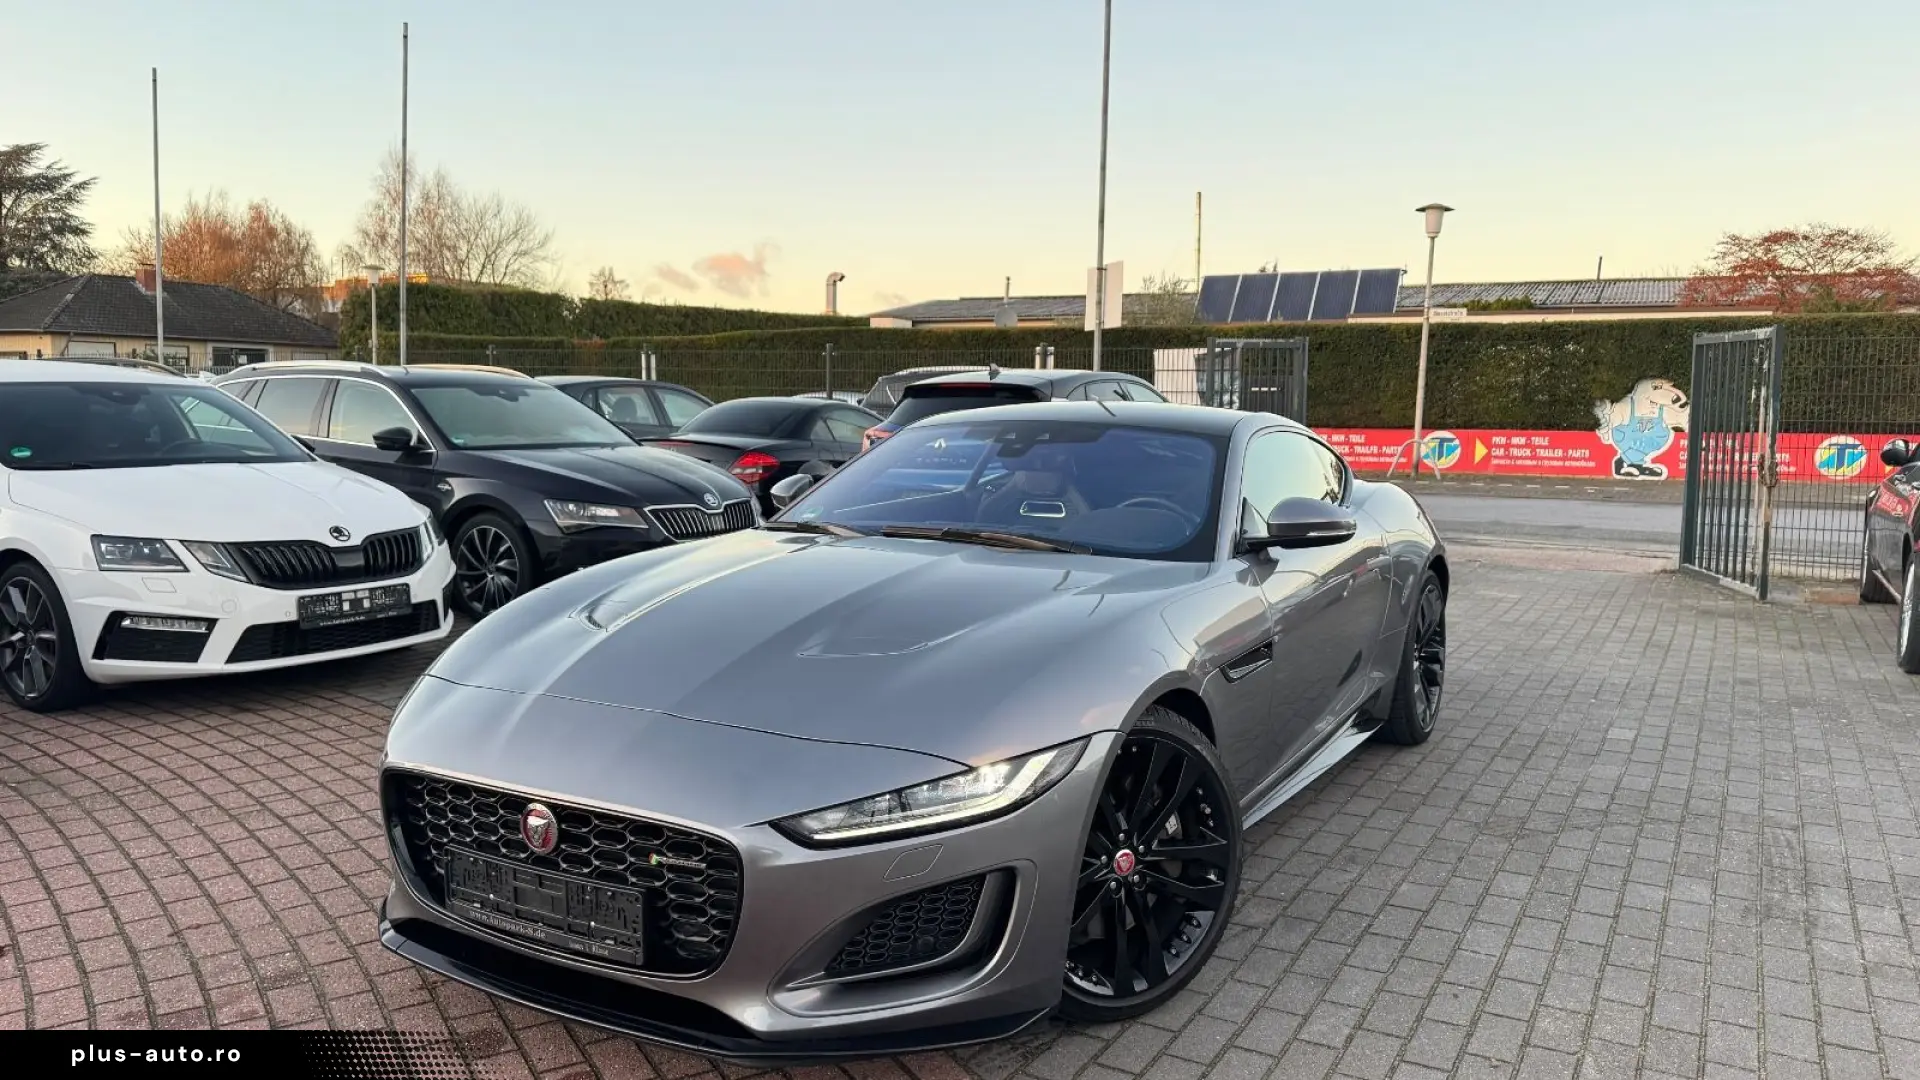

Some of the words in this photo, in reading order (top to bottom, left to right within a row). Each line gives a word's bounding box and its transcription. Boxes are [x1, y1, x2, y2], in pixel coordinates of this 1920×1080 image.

[1531, 437, 1549, 445] TEILE
[1491, 447, 1505, 456] CAR
[1509, 448, 1531, 456] TRUCK
[1536, 448, 1563, 457] TRAILER
[1567, 449, 1590, 458] PARTS
